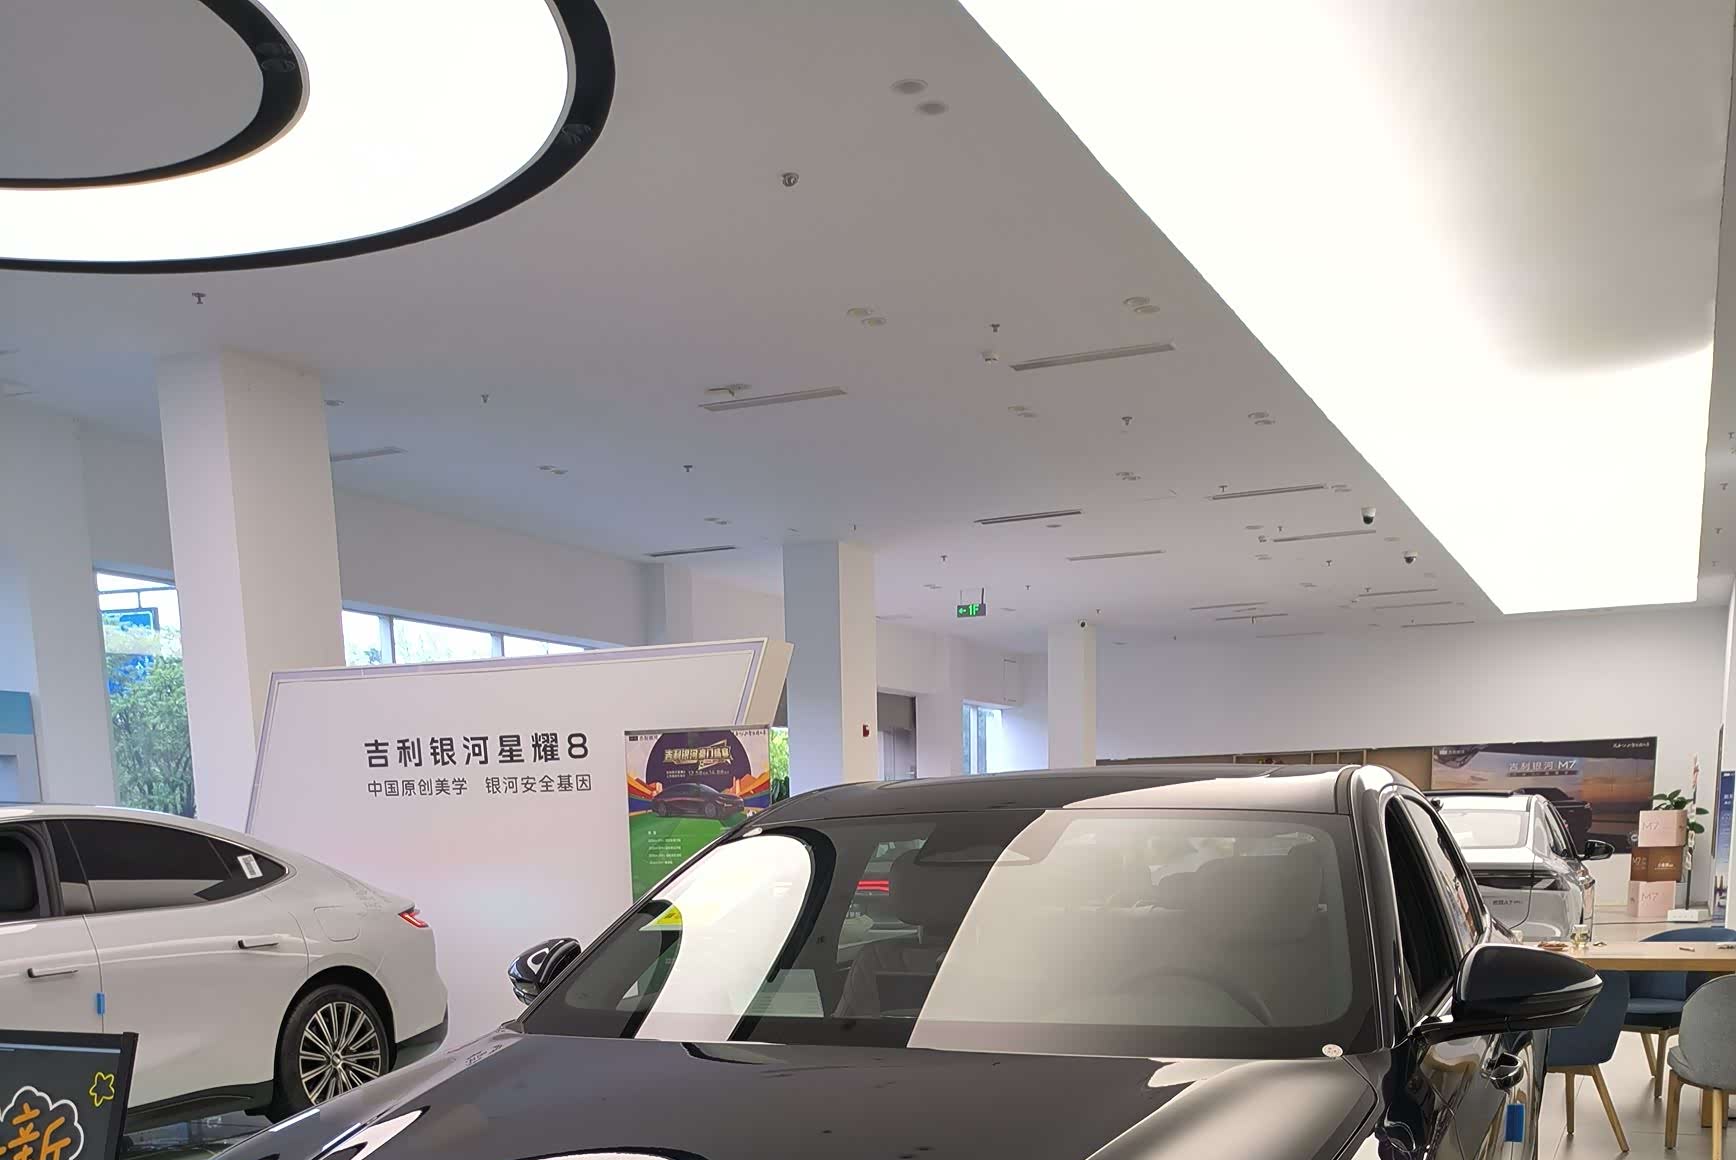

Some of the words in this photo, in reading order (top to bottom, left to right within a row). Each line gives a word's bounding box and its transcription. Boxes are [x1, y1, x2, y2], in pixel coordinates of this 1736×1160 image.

[364, 732, 589, 768] 吉利银河星耀8
[1558, 759, 1577, 769] M7
[367, 777, 468, 797] 中国原创美学
[485, 774, 592, 795] 银河安全基因
